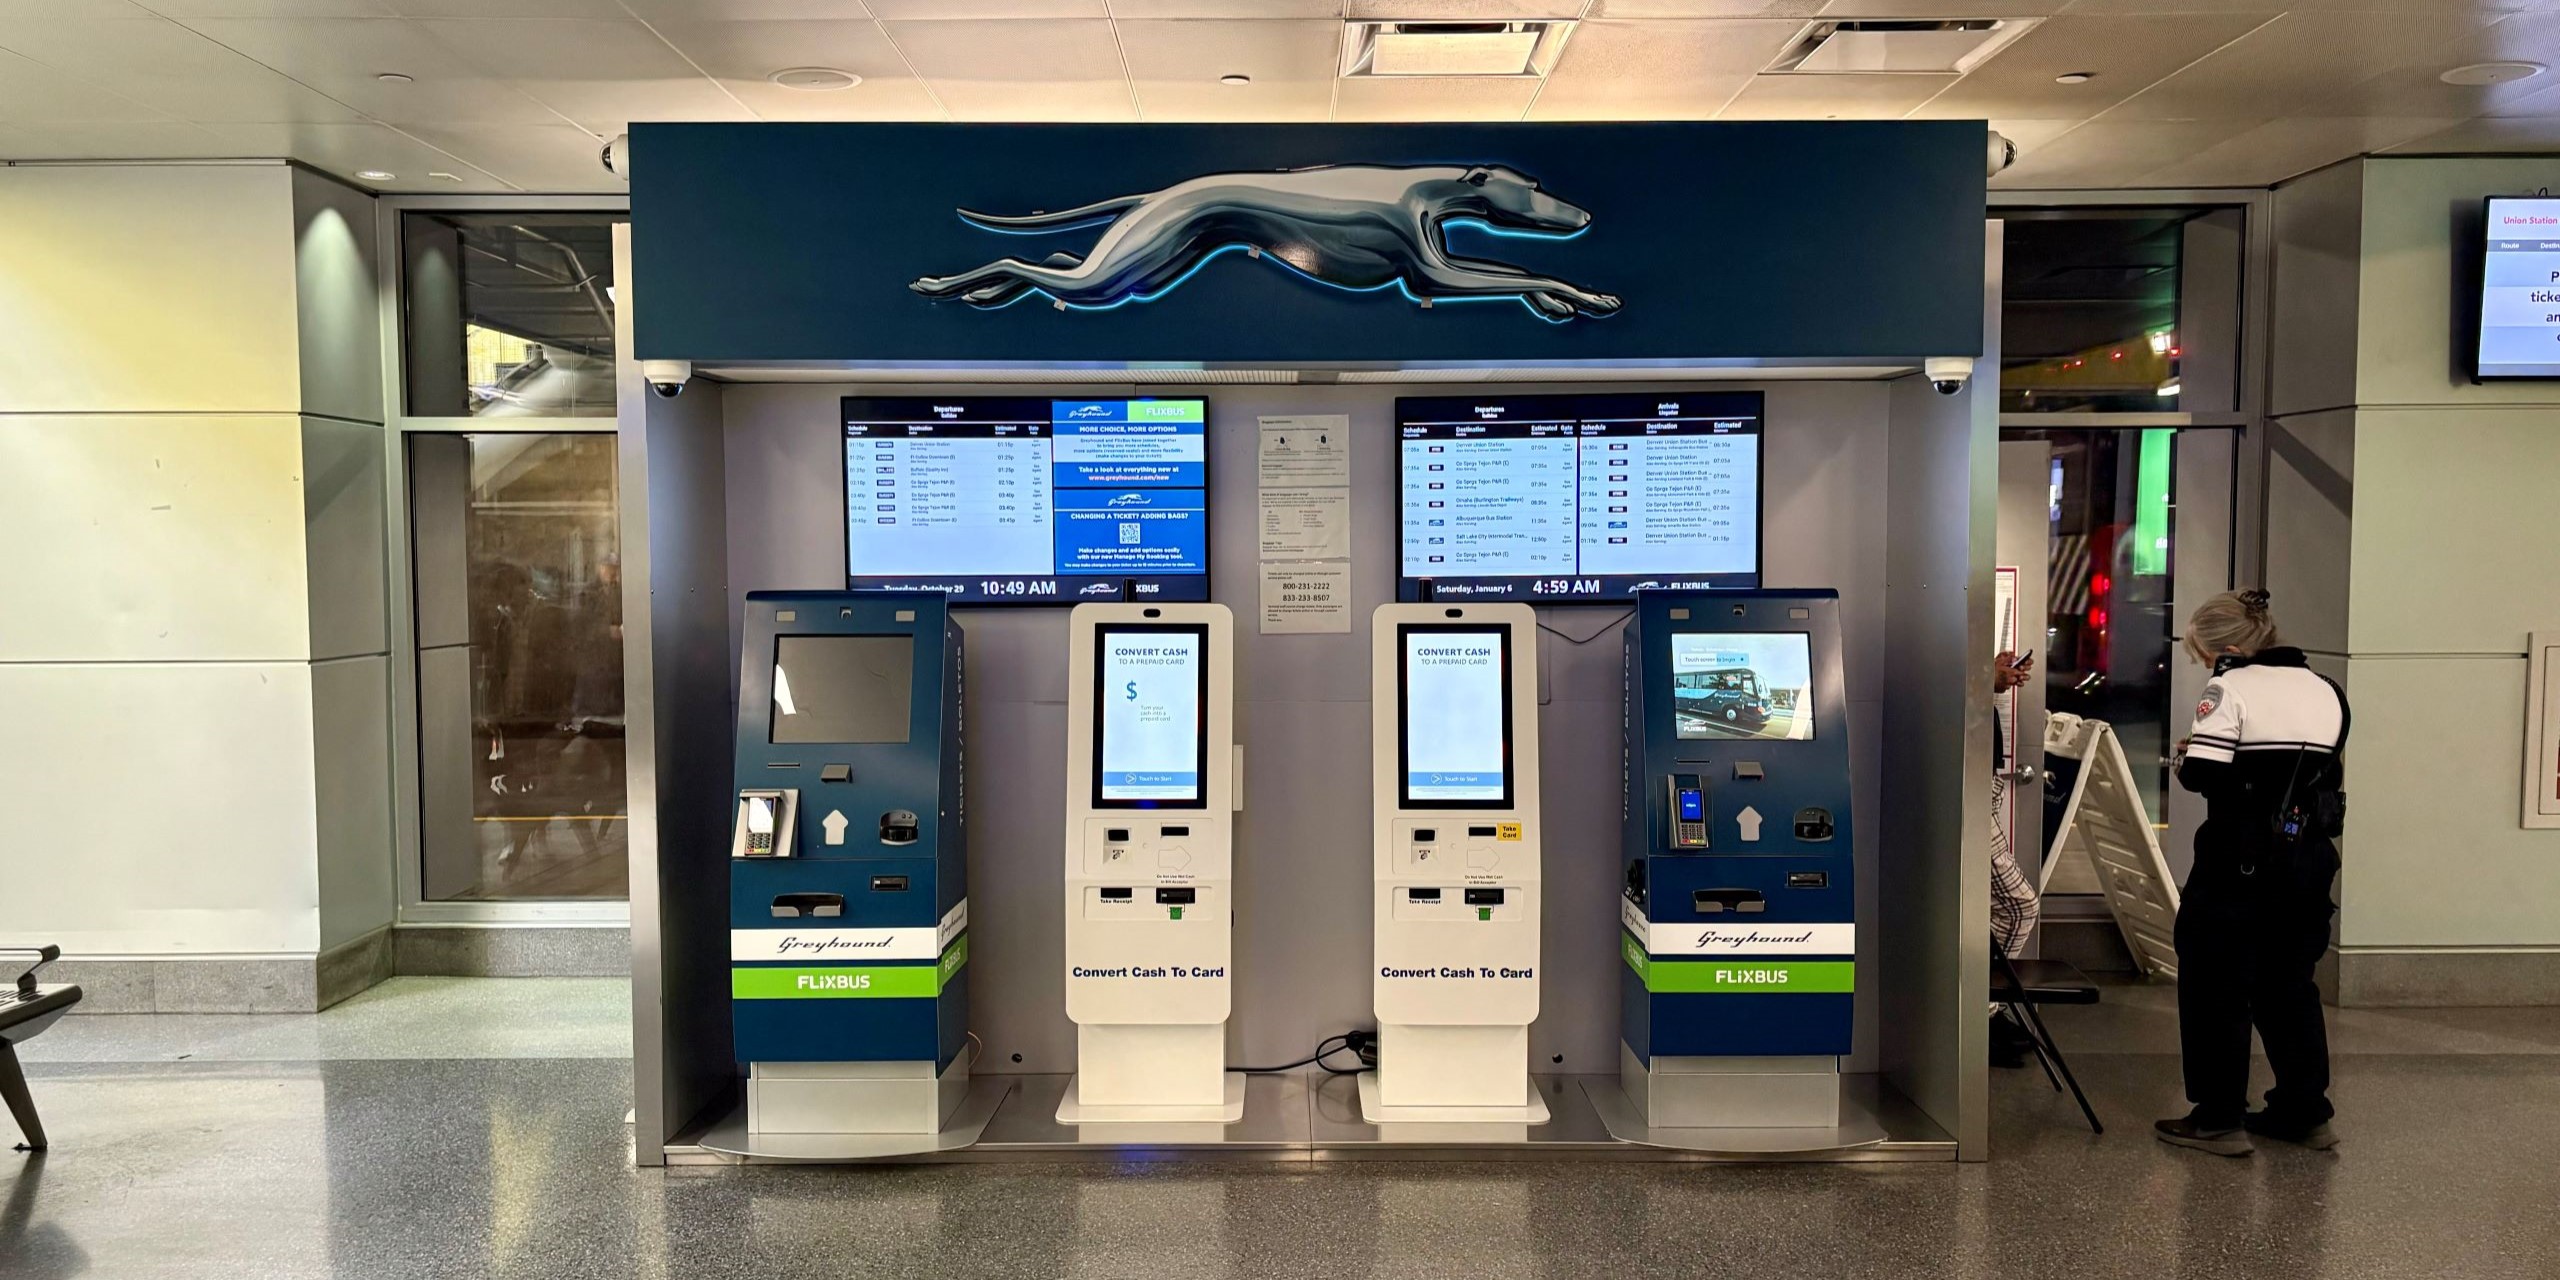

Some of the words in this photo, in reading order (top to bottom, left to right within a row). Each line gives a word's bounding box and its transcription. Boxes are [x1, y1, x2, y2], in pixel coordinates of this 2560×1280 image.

[1146, 408, 1184, 416] FLIXBUS
[954, 585, 964, 593] 29
[981, 581, 1025, 594] 10:49
[1029, 581, 1056, 594] AM
[1533, 580, 1568, 594] 4:59
[1572, 580, 1599, 593] AM
[1126, 680, 1137, 702] $
[777, 936, 894, 953] Greyhound
[1696, 931, 1813, 948] Greyhound
[1073, 967, 1127, 978] Convert
[1132, 967, 1166, 978] Cash
[1171, 967, 1186, 978] To
[1192, 967, 1224, 978] Card
[1381, 967, 1435, 978] Convert
[1440, 967, 1474, 978] Cash
[1480, 967, 1495, 978] To
[1500, 967, 1532, 978] Card
